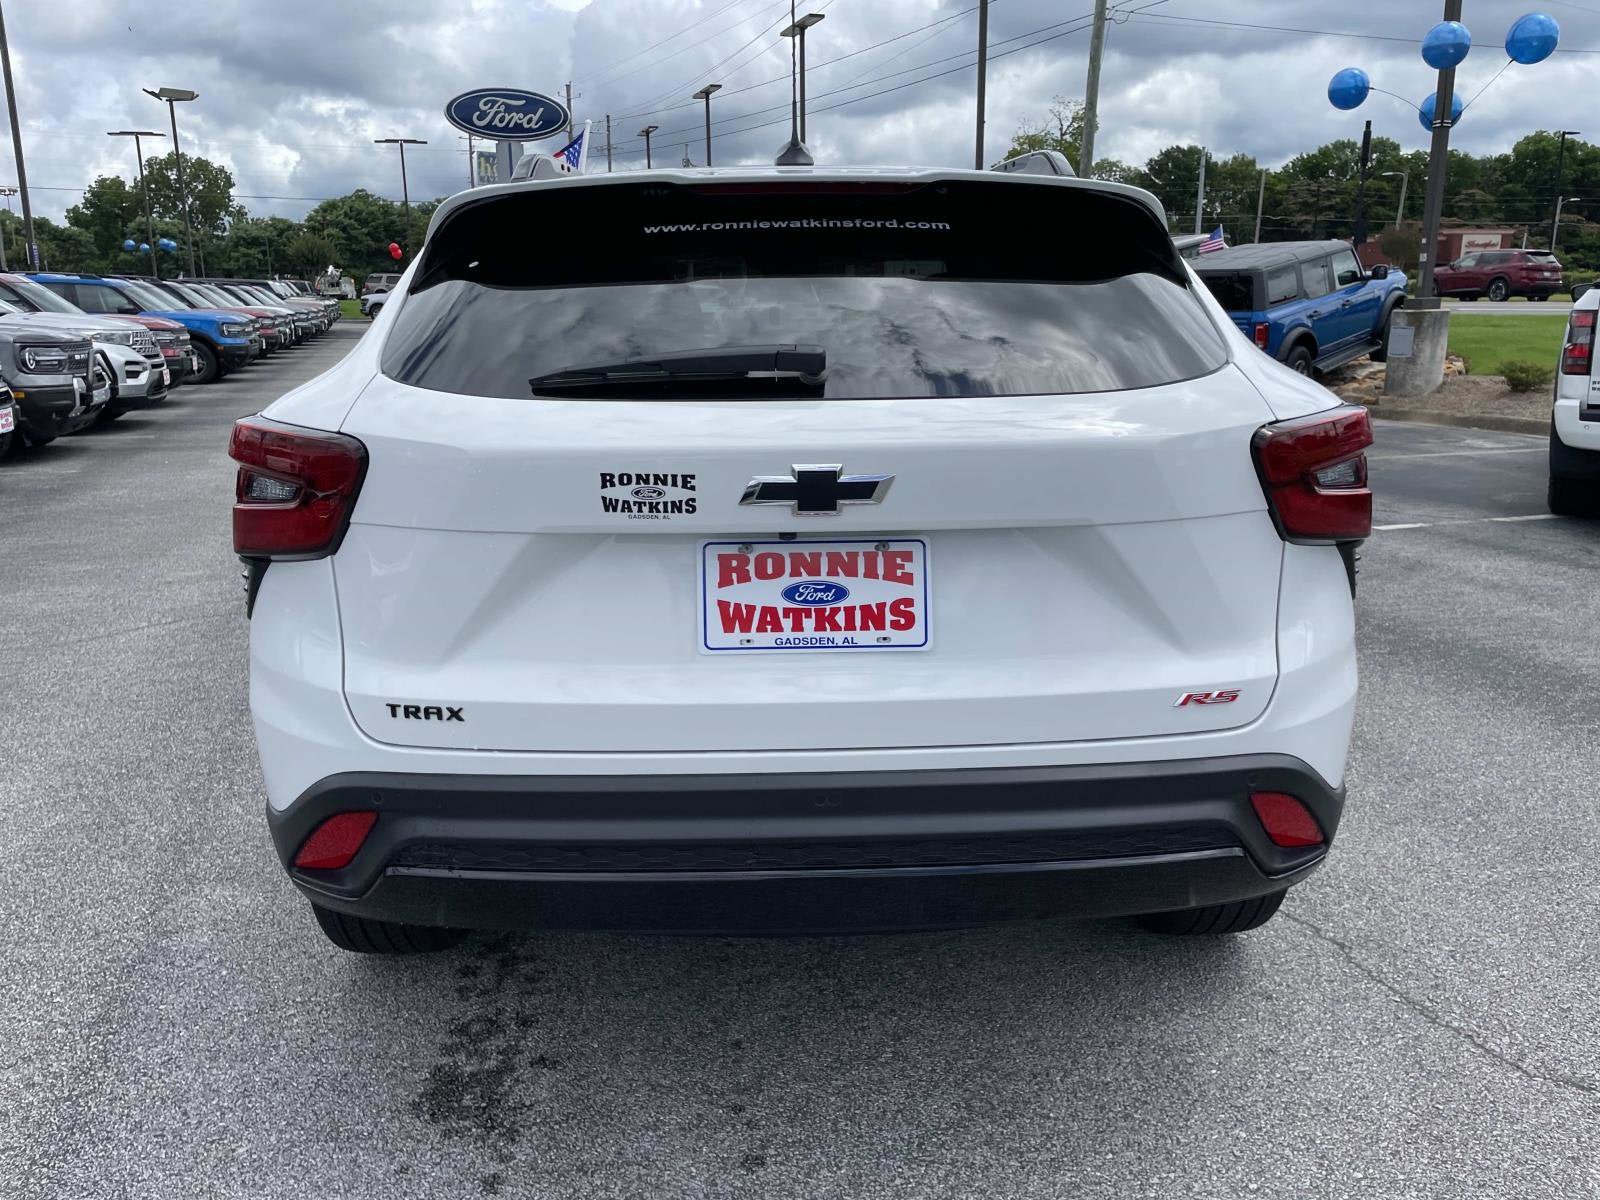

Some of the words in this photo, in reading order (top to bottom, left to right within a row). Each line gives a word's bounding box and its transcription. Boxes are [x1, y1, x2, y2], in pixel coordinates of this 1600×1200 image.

[472, 96, 544, 129] Ford
[643, 217, 951, 234] www.ronniewatkinsford.com
[599, 472, 697, 491] RONNIE
[600, 495, 697, 514] WATKINS
[717, 549, 914, 589] RONNIE
[794, 583, 836, 602] Ford
[716, 597, 916, 634] WATKINS
[774, 636, 839, 647] GADSDEN,
[841, 636, 858, 646] AL
[1172, 688, 1243, 707] RS
[385, 702, 465, 722] TRAX
